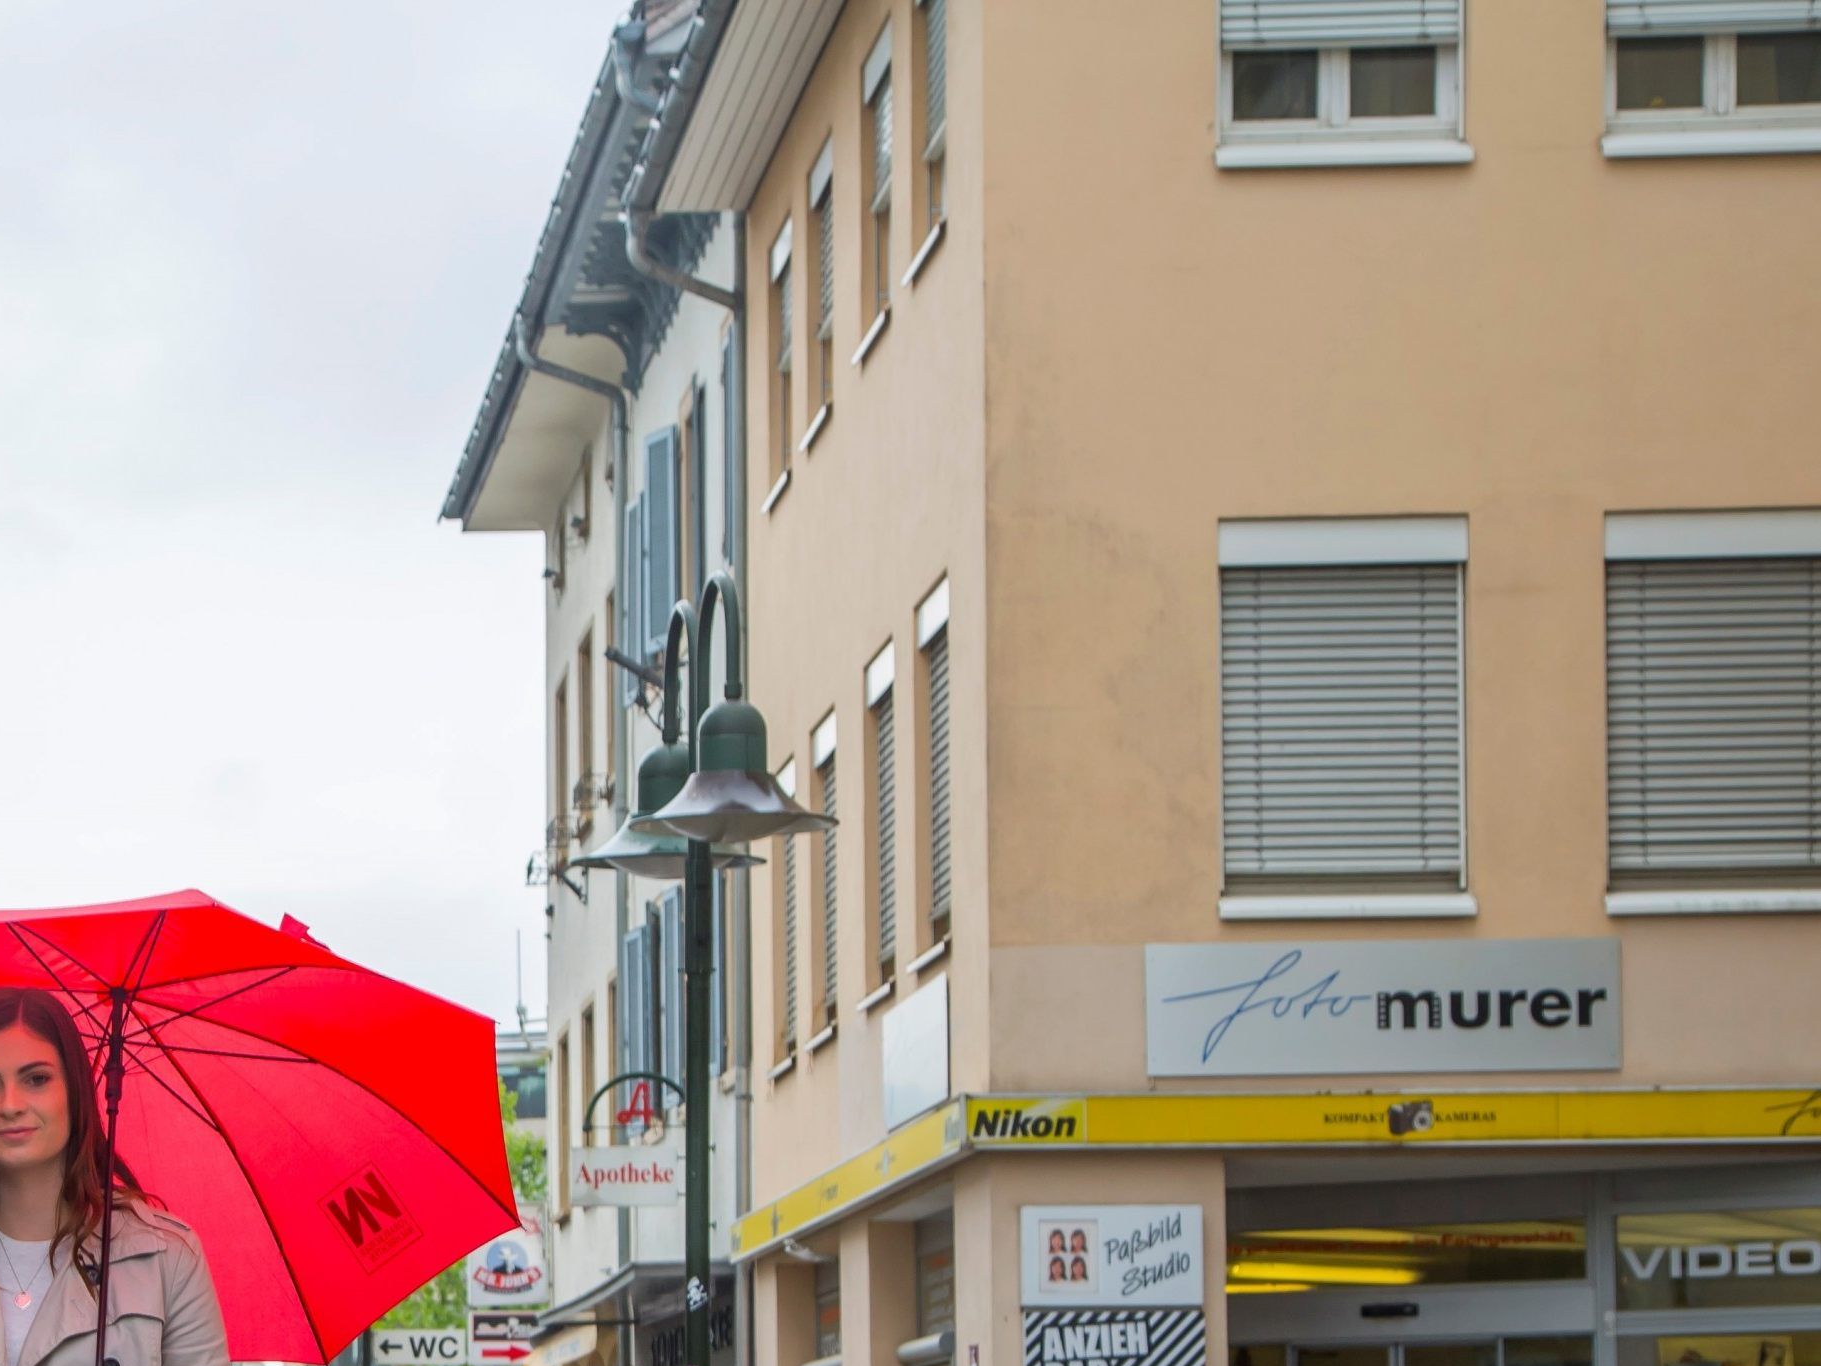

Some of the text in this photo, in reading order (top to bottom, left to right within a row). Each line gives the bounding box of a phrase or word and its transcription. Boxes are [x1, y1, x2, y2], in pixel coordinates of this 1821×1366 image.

[1162, 949, 1607, 1064] foto murer
[973, 1109, 1077, 1138] Nikon
[1324, 1110, 1497, 1124] KOMPAKT KAMERAS
[575, 1161, 674, 1190] Apotheke
[1105, 1211, 1183, 1266] Paßbild
[1122, 1251, 1191, 1296] Studio
[1621, 1239, 1821, 1280] VIDEO
[408, 1336, 459, 1359] WC
[1043, 1320, 1150, 1361] ANZIEH
